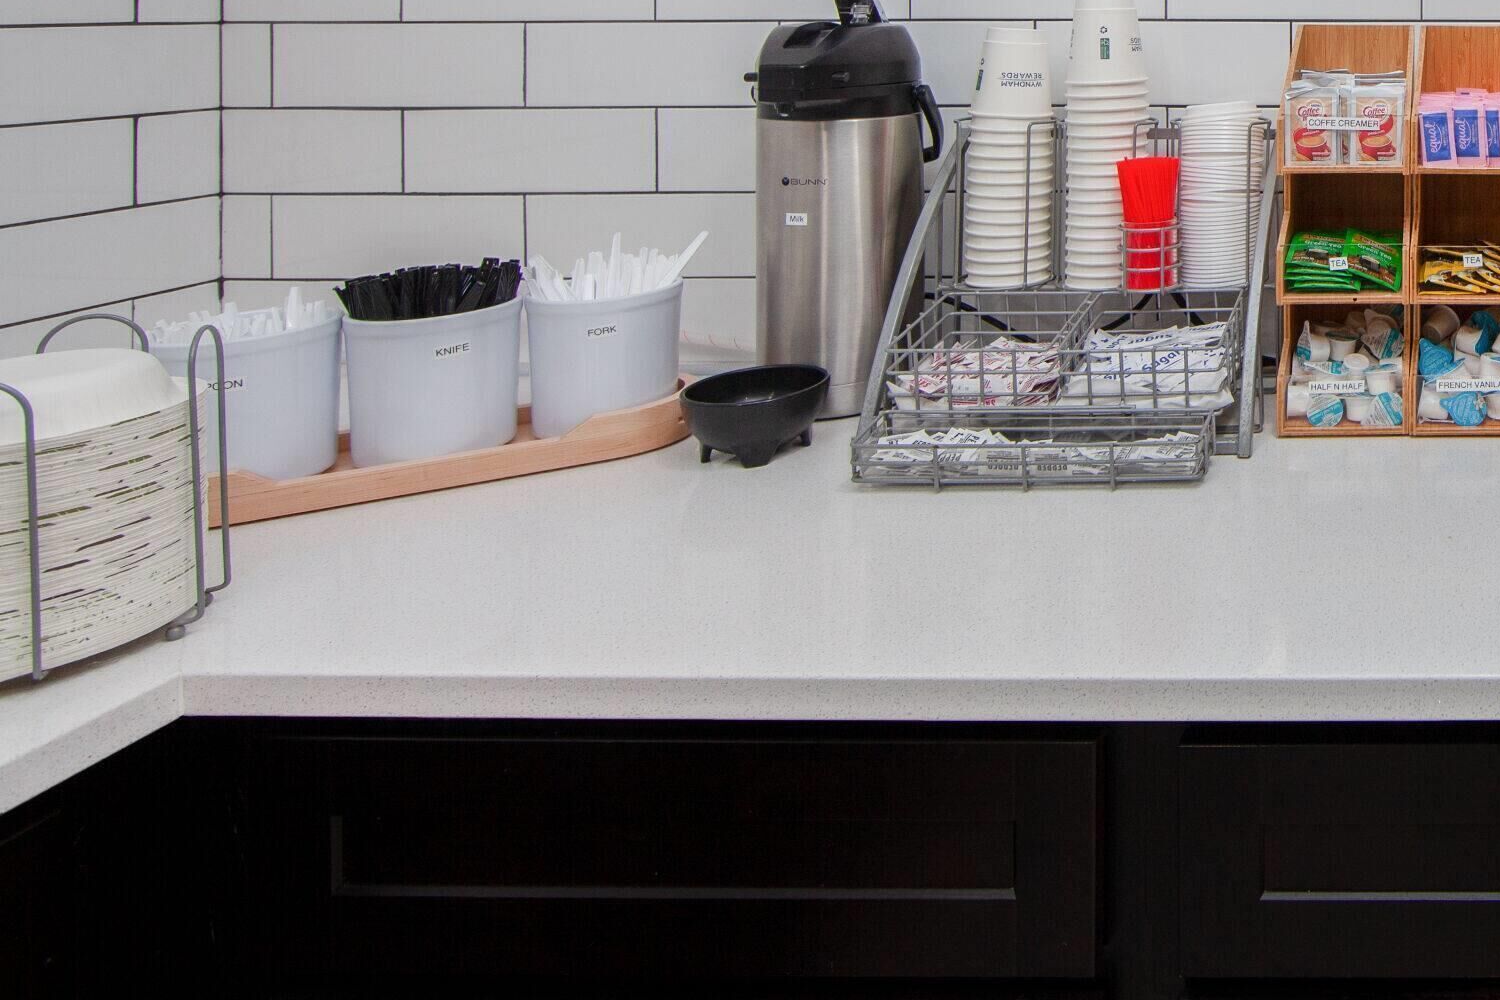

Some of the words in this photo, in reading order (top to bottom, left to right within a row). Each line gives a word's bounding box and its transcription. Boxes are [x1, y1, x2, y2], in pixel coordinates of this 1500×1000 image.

[1001, 71, 1043, 79] REWARDS
[1000, 80, 1043, 88] WYNDHAM
[1308, 118, 1336, 127] COFFE
[1338, 119, 1379, 128] CREAMER
[1424, 120, 1441, 153] equal
[1455, 117, 1471, 150] equal
[790, 178, 826, 186] BUNN
[1330, 259, 1348, 267] TEA
[1464, 256, 1481, 264] TEA
[587, 325, 617, 337] FORK
[435, 342, 471, 357] KNIFE
[1310, 383, 1332, 391] HALF
[1342, 382, 1363, 390] HALF
[1438, 381, 1473, 389] FRENCH
